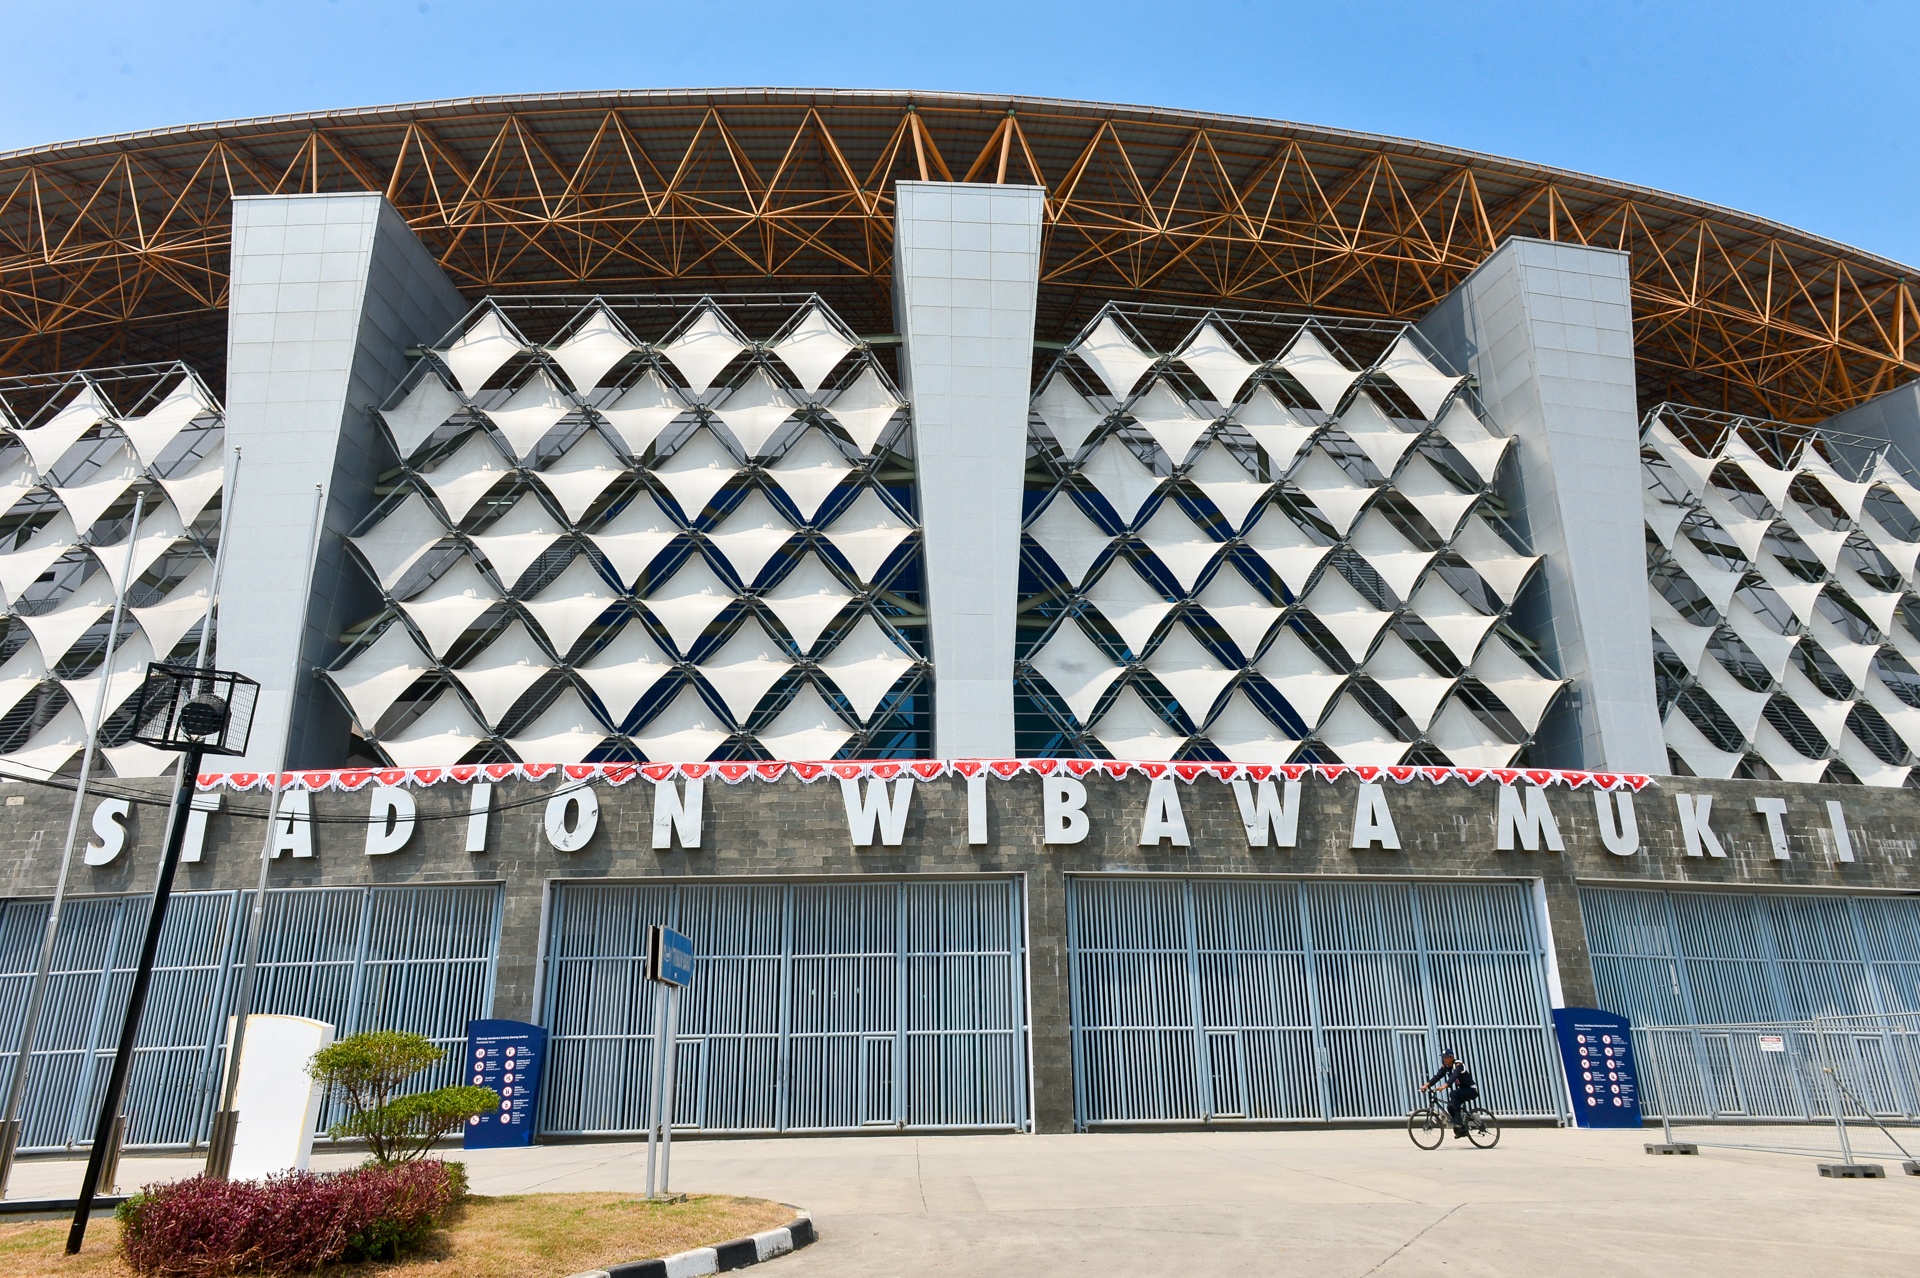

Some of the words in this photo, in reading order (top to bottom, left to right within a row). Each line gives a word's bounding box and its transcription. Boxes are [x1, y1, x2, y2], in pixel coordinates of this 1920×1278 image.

[84, 779, 704, 866] STADION
[840, 776, 1401, 849] WIBAWA
[1493, 786, 1855, 864] MUKTI
